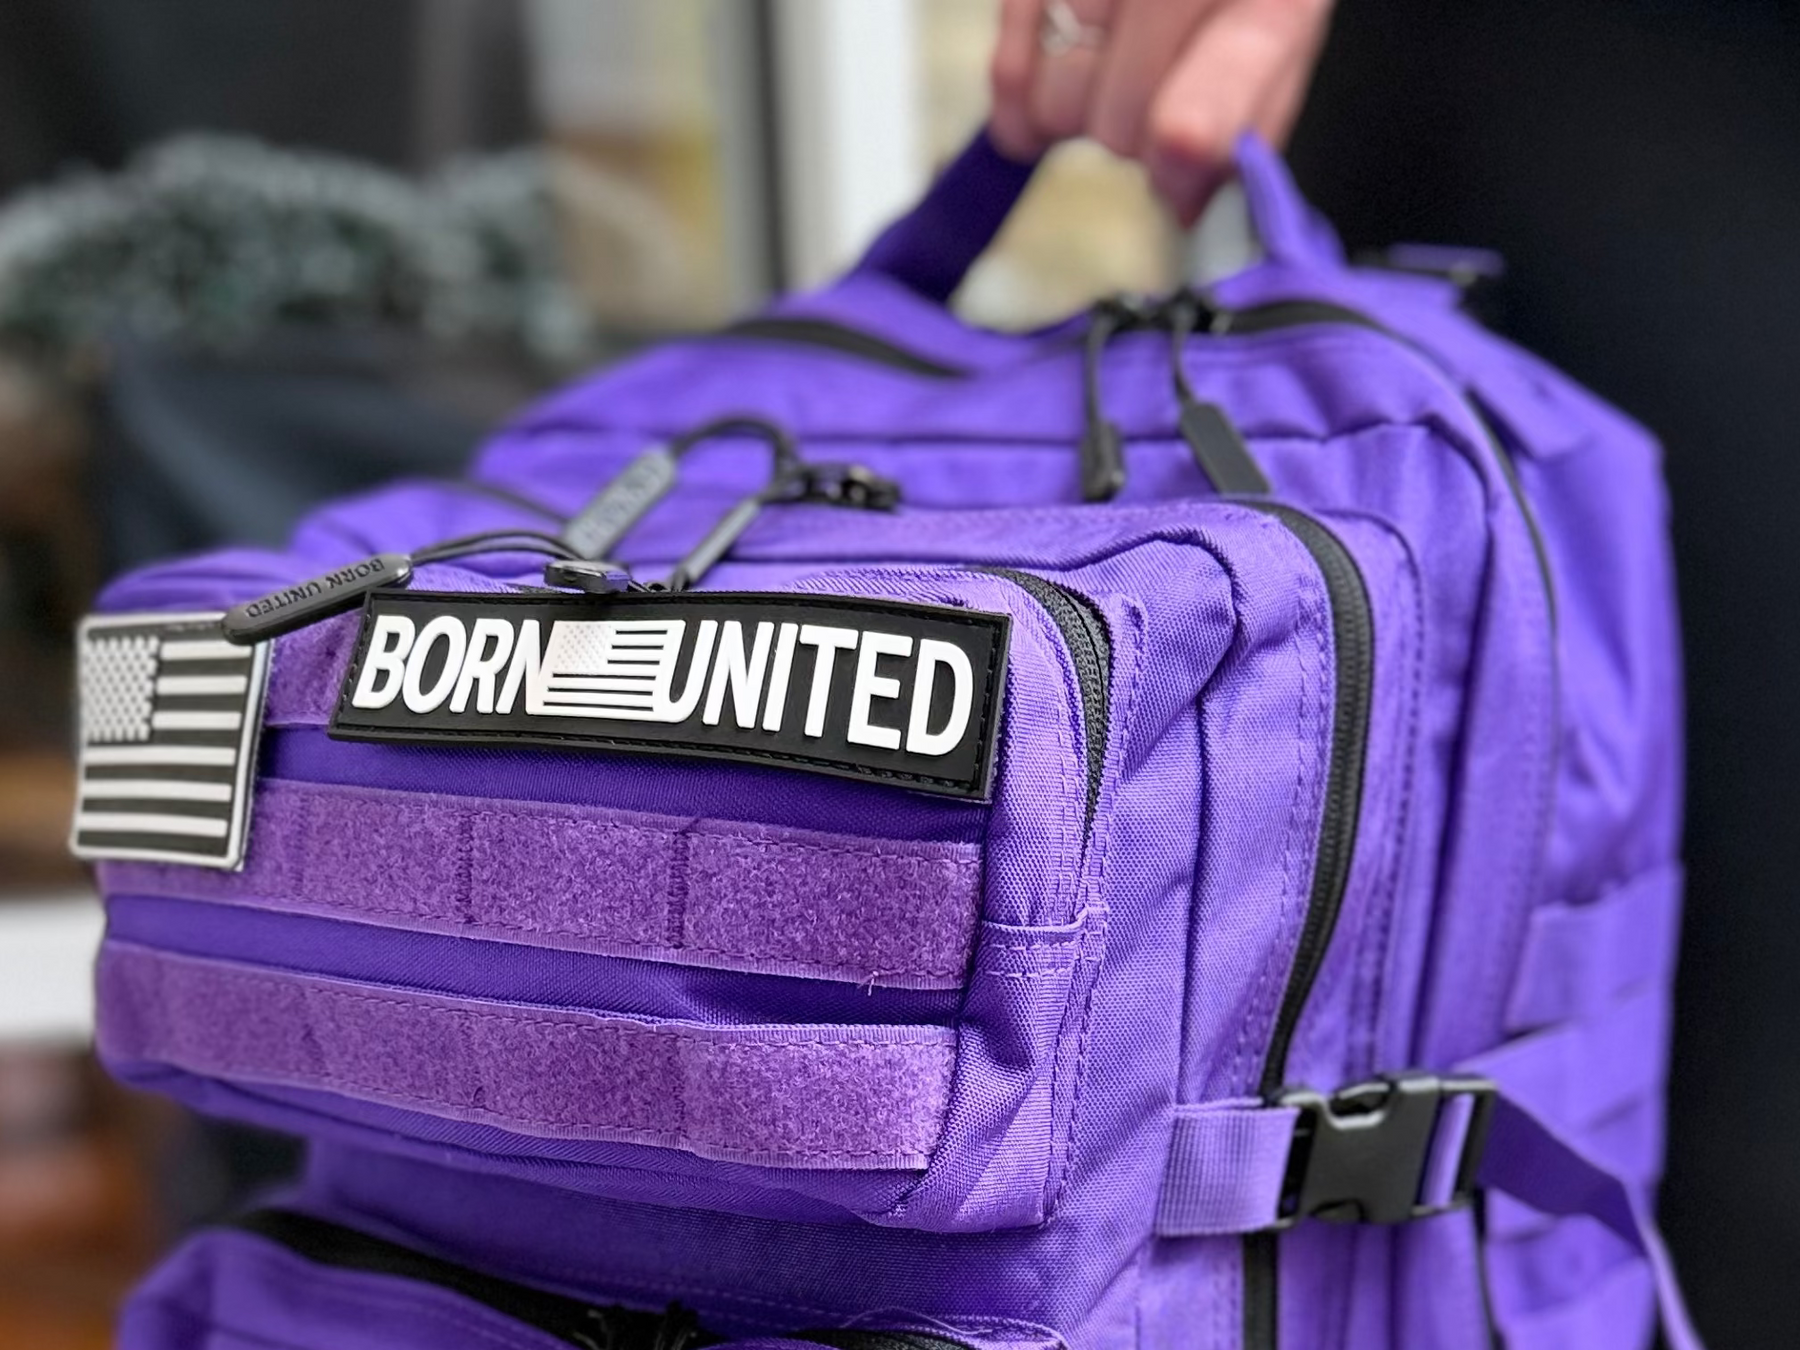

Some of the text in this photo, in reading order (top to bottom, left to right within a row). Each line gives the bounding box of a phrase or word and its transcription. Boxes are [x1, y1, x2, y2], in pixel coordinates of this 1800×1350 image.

[246, 557, 386, 618] BORN UNITED
[350, 614, 975, 757] BORN UNITED
